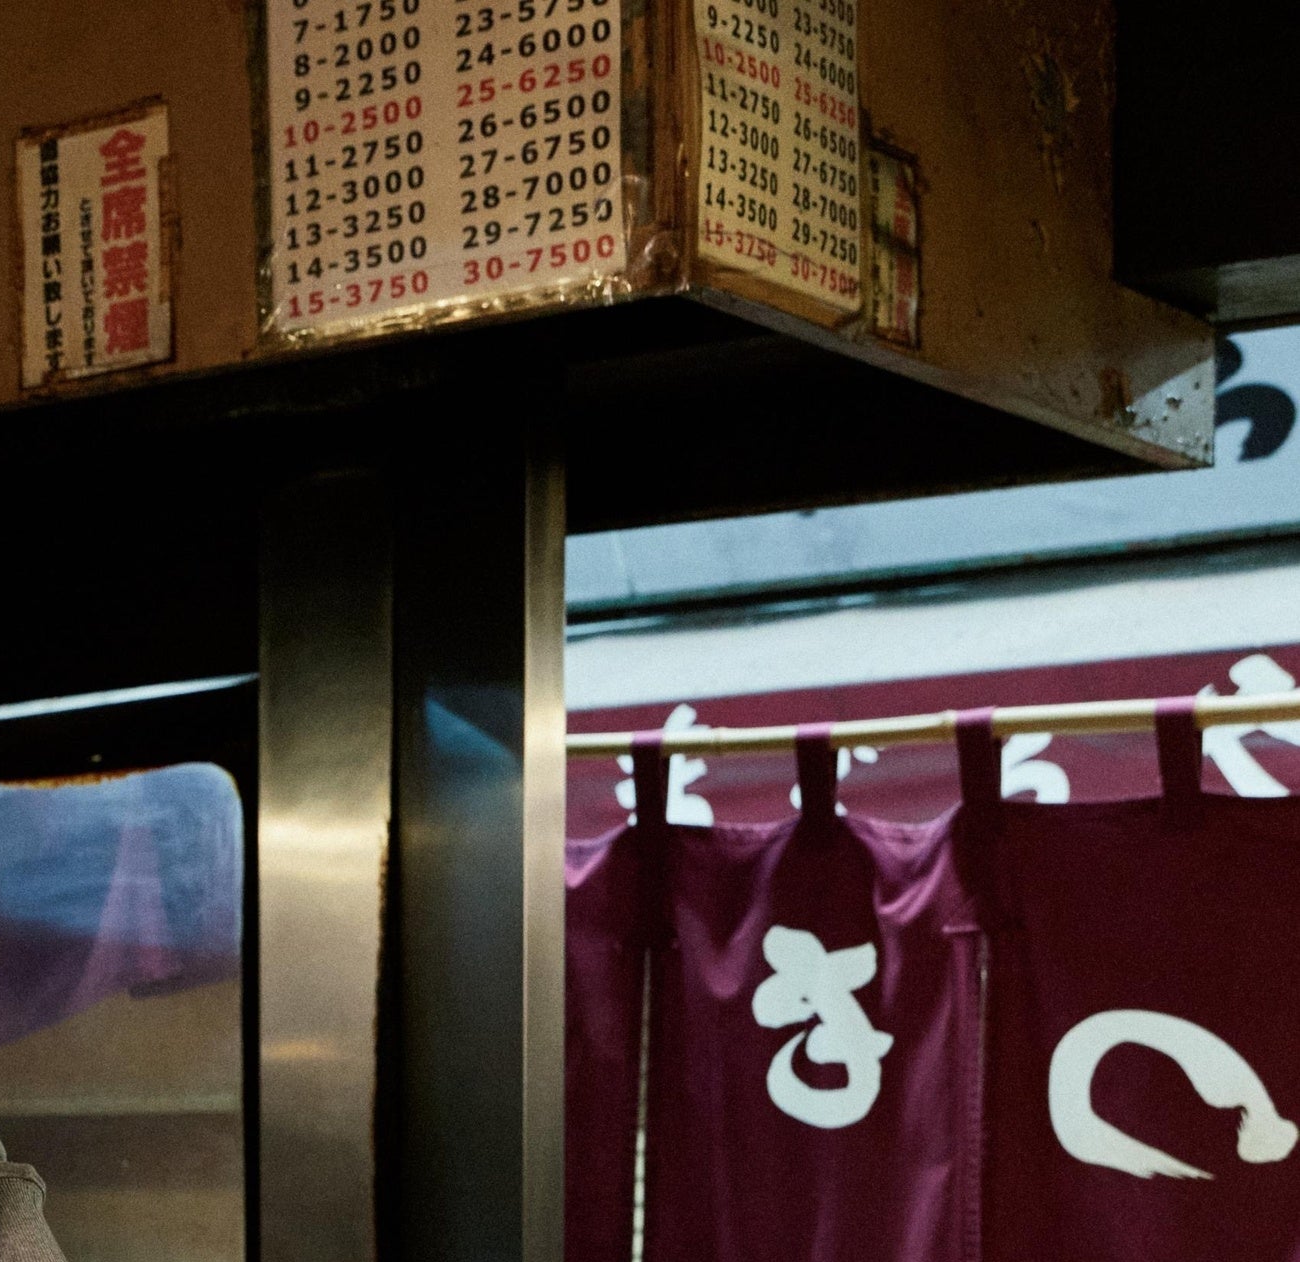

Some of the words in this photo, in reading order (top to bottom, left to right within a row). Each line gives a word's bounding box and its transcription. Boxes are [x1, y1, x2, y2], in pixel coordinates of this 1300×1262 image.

[455, 0, 611, 37] 23-575
[707, 5, 780, 54] 9-2250
[793, 8, 854, 61] 23-5750
[294, 26, 421, 76] 8-2000
[456, 19, 611, 72] 24-6000
[703, 37, 780, 90] 10-2500
[793, 43, 855, 95] 24-6000
[295, 61, 421, 111] 9-2250
[456, 54, 611, 107] 25-6250
[706, 72, 780, 125] 11-2750
[794, 77, 856, 129] 25-6250
[285, 96, 422, 148] 10-2500
[458, 90, 611, 143] 26-6500
[708, 109, 779, 161] 12-3000
[793, 111, 856, 164] 26-6500
[286, 131, 423, 182] 11-2750
[459, 125, 611, 178] 27-6750
[707, 146, 778, 197] 13-3250
[792, 147, 857, 197] 27-6750
[286, 166, 424, 216] 12-3000
[461, 162, 612, 214] 28-7000
[705, 182, 777, 231] 14-3500
[792, 183, 857, 232] 28-7000
[100, 128, 149, 355] 全席禁煙
[287, 201, 425, 250] 13-3250
[463, 198, 613, 250] 29-7250
[704, 219, 777, 268] 15-3750
[791, 219, 857, 266] 29-7250
[288, 236, 427, 284] 14-3500
[464, 234, 615, 285] 30-7500
[791, 253, 858, 298] 30-7500
[289, 271, 429, 318] 15-3750
